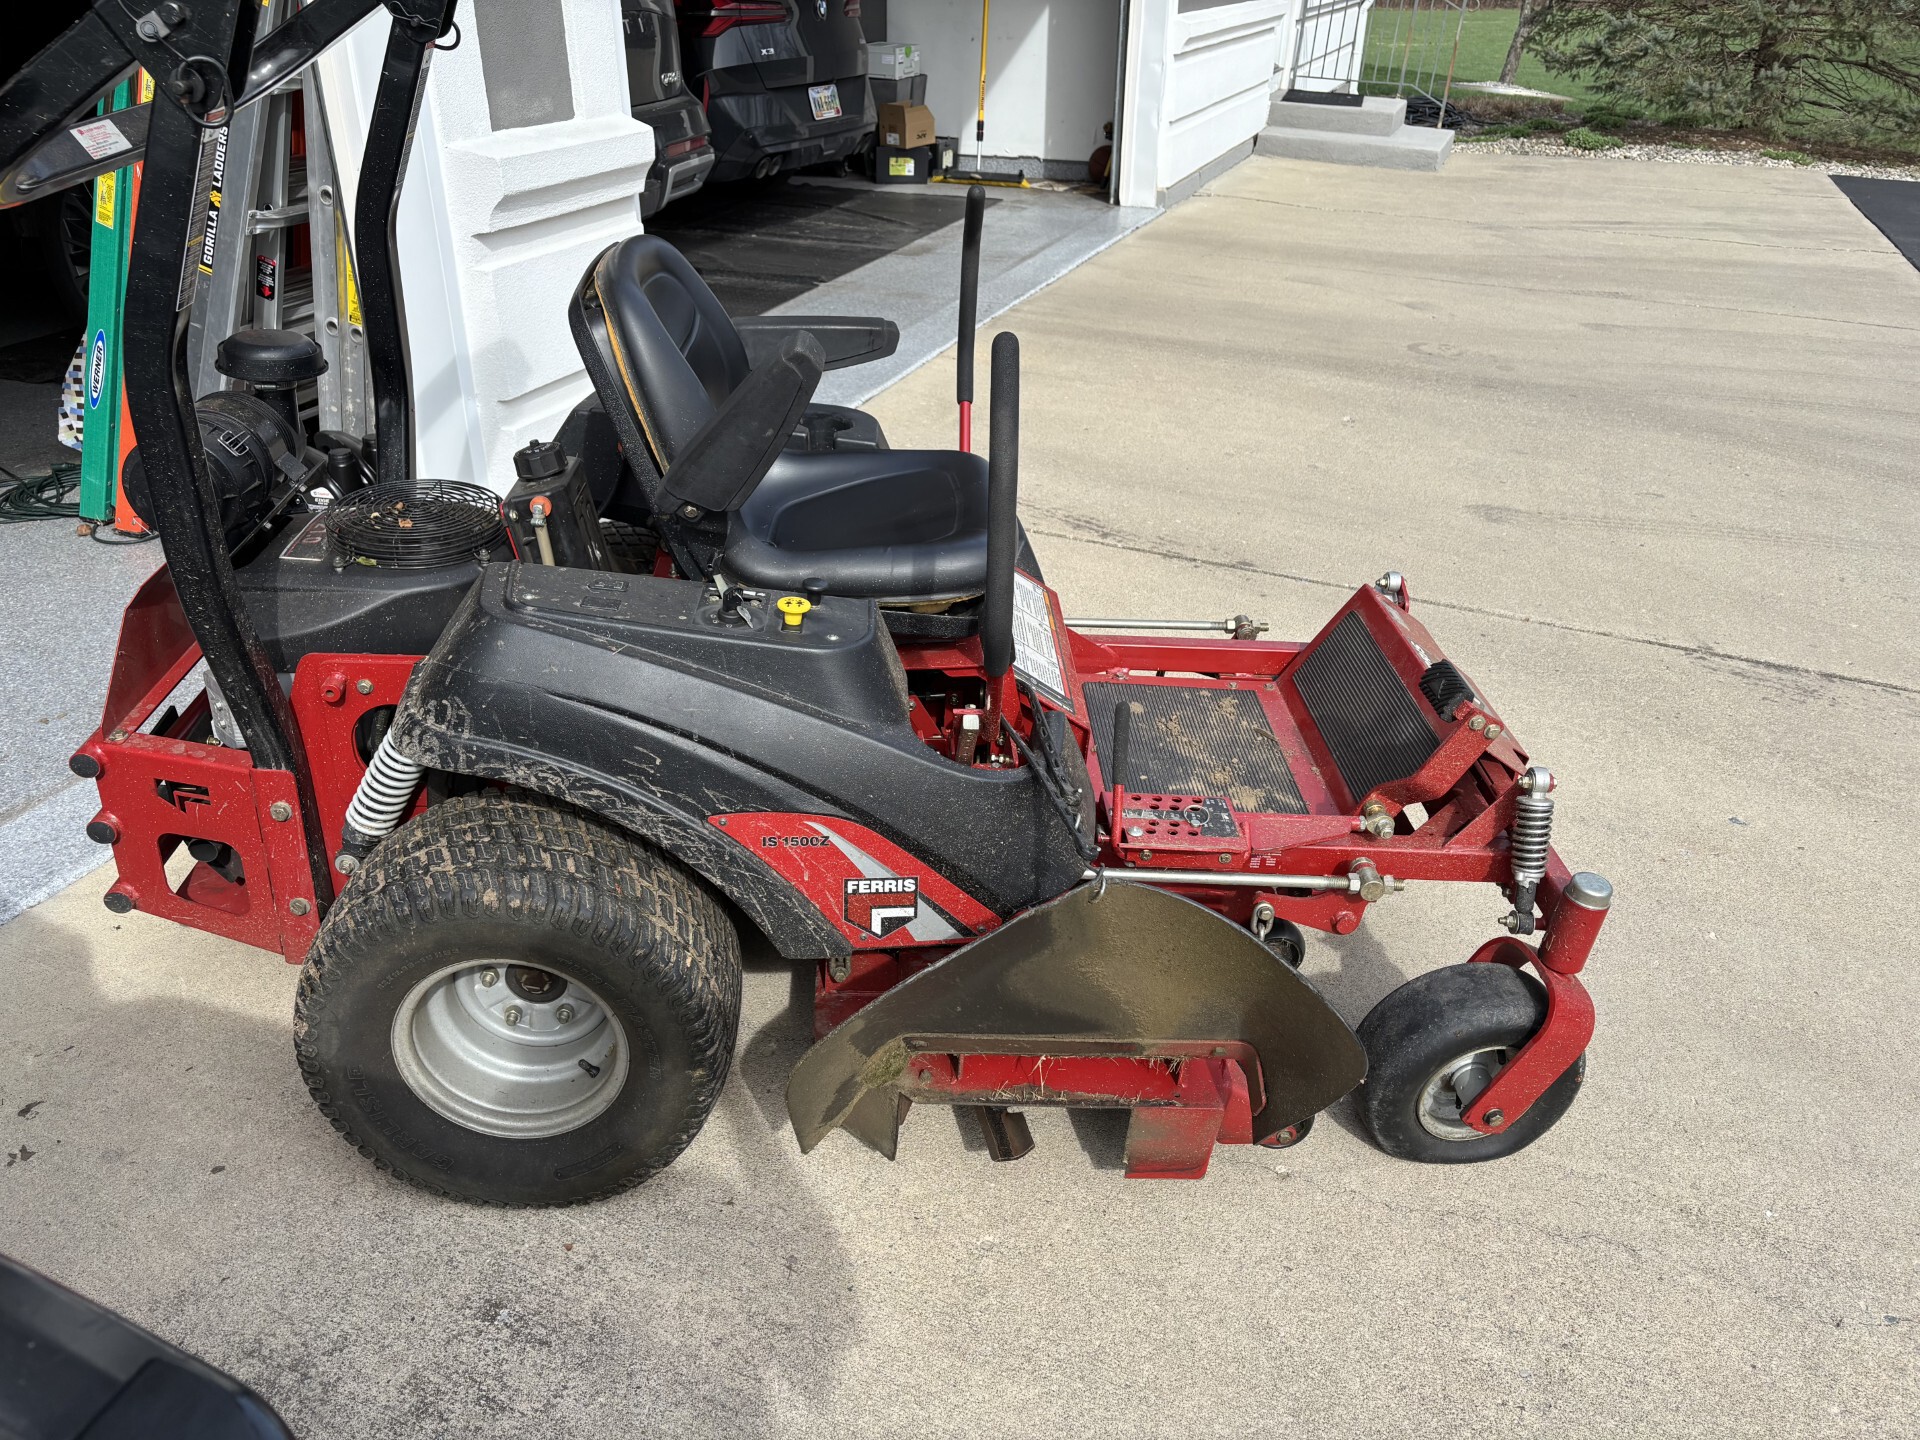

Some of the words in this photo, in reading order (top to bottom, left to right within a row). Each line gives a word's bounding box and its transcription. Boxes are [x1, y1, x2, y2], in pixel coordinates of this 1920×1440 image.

[760, 47, 775, 56] X3
[203, 210, 219, 265] GORILLA
[213, 126, 229, 188] LADDERS
[92, 345, 103, 394] WERNER
[762, 836, 778, 847] IS
[783, 835, 830, 848] 1500Z
[847, 879, 916, 894] FERRIS
[346, 1063, 455, 1170] CARLISLE
